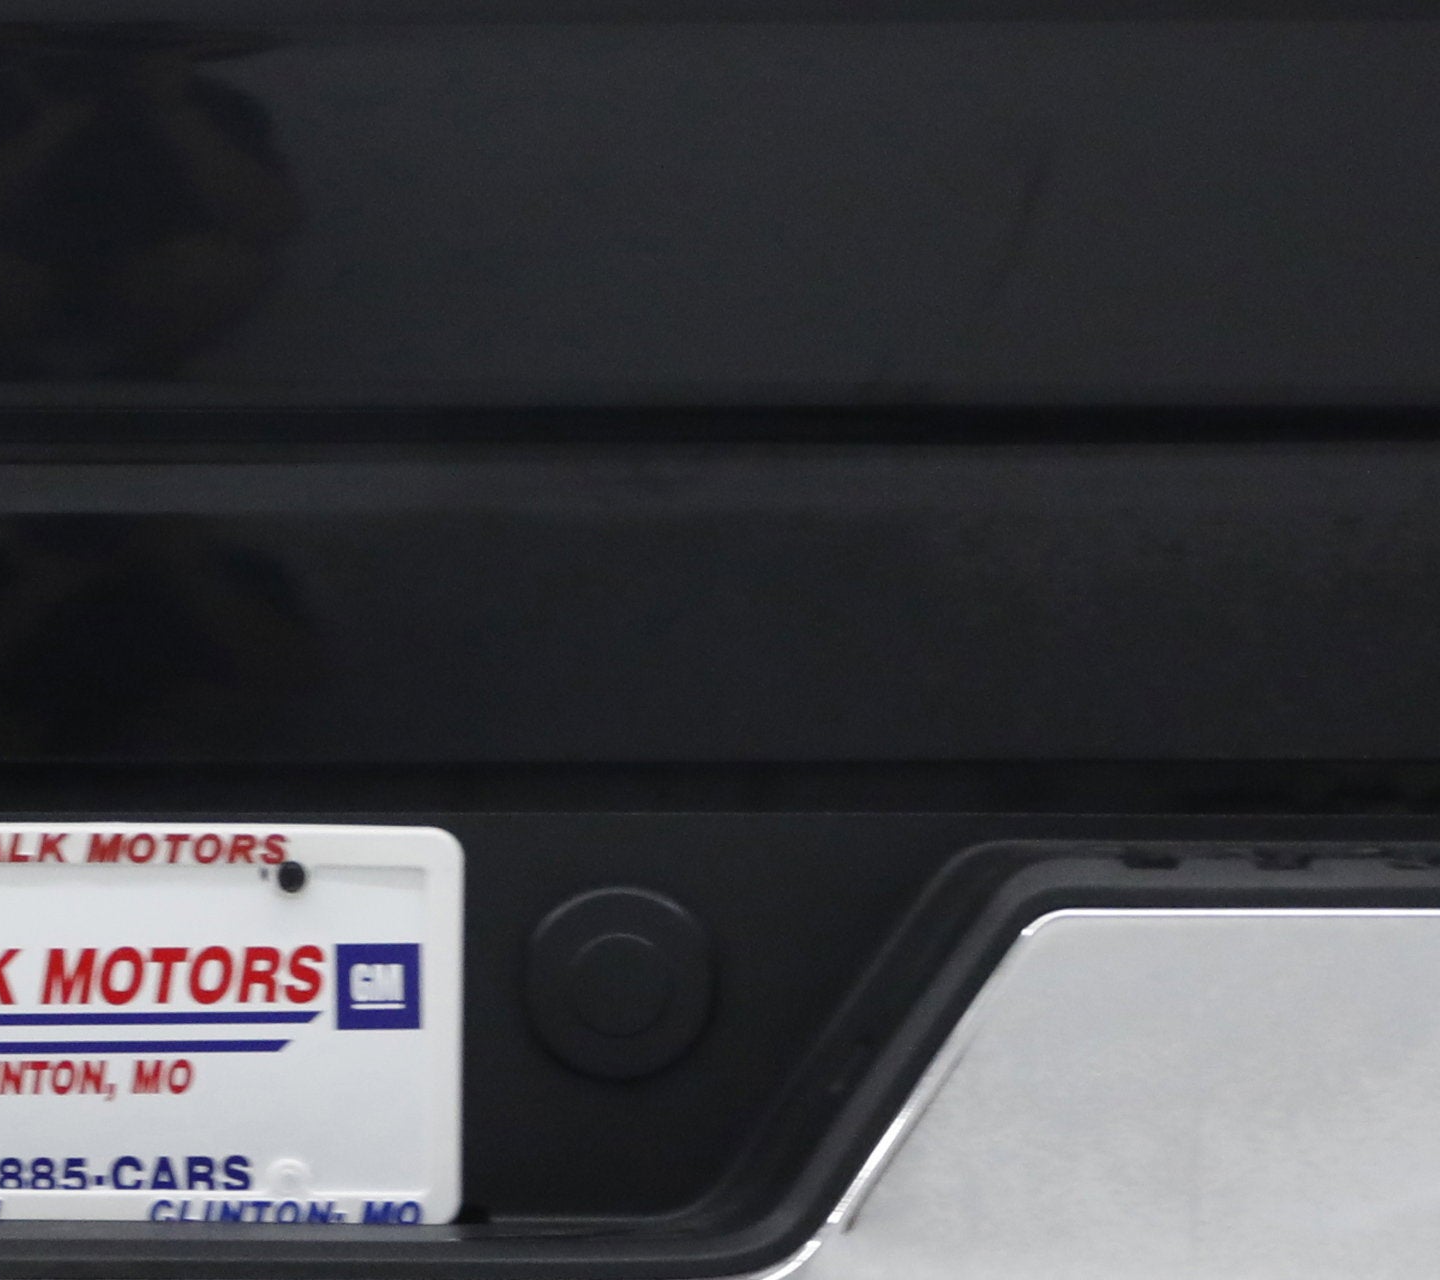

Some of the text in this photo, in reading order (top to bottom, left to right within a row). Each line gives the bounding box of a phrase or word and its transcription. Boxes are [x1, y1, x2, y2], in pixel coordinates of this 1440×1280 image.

[84, 832, 290, 865] MOTORS
[38, 945, 326, 1006] MOTORS
[348, 962, 407, 1003] GM
[130, 1058, 196, 1096] MO
[360, 1200, 426, 1225] MO
